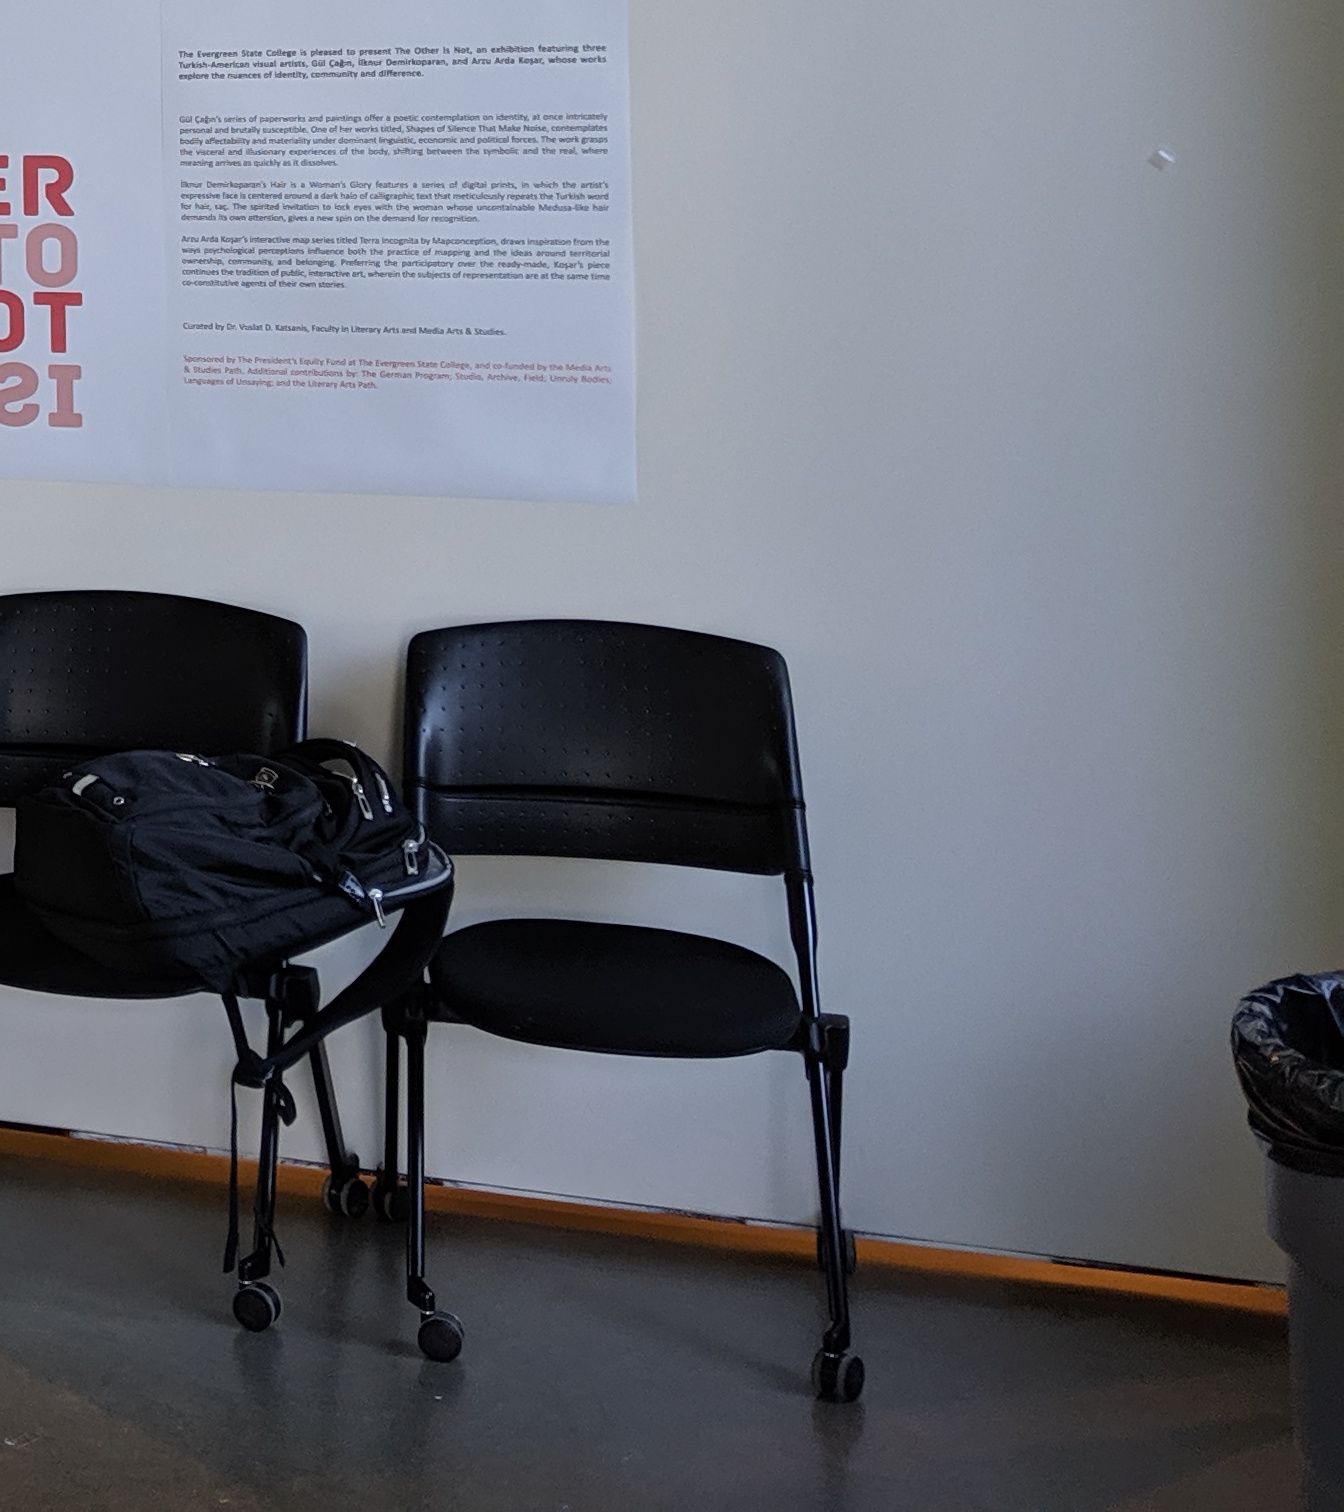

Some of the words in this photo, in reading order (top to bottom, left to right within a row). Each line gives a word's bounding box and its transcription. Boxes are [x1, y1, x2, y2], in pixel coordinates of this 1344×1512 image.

[178, 50, 193, 58] The
[197, 49, 237, 60] Evergreen
[241, 48, 262, 57] State
[266, 48, 296, 58] College
[300, 48, 306, 56] is
[310, 47, 342, 58] pleased
[346, 47, 355, 55] to
[359, 46, 391, 57] present
[395, 46, 410, 54] The
[414, 46, 438, 54] Other
[443, 45, 449, 54] Is
[490, 44, 534, 53] exhibition
[538, 43, 578, 54] featuring
[582, 43, 606, 51] three
[280, 59, 308, 68] artists,
[452, 56, 468, 65] and
[494, 56, 514, 64] Arda
[548, 55, 576, 63] whose
[179, 71, 208, 81] explore
[211, 71, 225, 79] the
[263, 70, 272, 78] of
[360, 69, 375, 77] and
[224, 114, 246, 123] series
[248, 114, 256, 122] of
[260, 114, 305, 124] paperworks
[308, 114, 322, 122] and
[326, 113, 362, 124] paintings
[364, 113, 383, 122] offer
[393, 113, 418, 123] poetic
[180, 125, 212, 136] personal
[214, 125, 228, 134] and
[406, 124, 434, 134] Shapes
[478, 124, 495, 132] That
[498, 123, 520, 132] Make
[313, 136, 335, 144] under
[418, 135, 457, 144] economic
[460, 135, 475, 143] and
[477, 135, 509, 145] political
[541, 135, 556, 143] The
[558, 135, 579, 143] work
[289, 147, 336, 157] experiences
[339, 147, 348, 155] of
[351, 147, 364, 155] the
[368, 147, 389, 157] body,
[426, 146, 462, 155] between
[465, 146, 479, 155] the
[523, 146, 538, 154] and
[581, 146, 608, 154] where
[253, 158, 280, 168] quickly
[300, 158, 338, 166] dissolves.
[375, 180, 408, 188] features
[461, 180, 486, 190] digital
[491, 180, 517, 190] prints,
[562, 180, 576, 188] the
[181, 191, 220, 201] expressive
[222, 191, 238, 199] face
[248, 191, 282, 199] centered
[320, 191, 338, 199] dark
[416, 191, 432, 199] text
[434, 191, 450, 199] that
[507, 191, 537, 202] repeats
[556, 191, 585, 200] Turkish
[232, 202, 247, 210] The
[353, 204, 371, 212] eyes
[375, 202, 392, 210] with
[446, 202, 473, 211] whose
[288, 213, 307, 223] gives
[336, 213, 352, 223] spin
[250, 235, 290, 243] interactive
[312, 235, 334, 243] series
[336, 235, 357, 244] titled
[360, 235, 379, 244] Terra
[421, 236, 430, 246] by
[501, 237, 525, 245] draws
[573, 237, 593, 246] from
[307, 246, 344, 255] influence
[348, 247, 366, 255] both
[370, 247, 383, 255] the
[387, 247, 419, 257] practice
[182, 267, 219, 275] continues
[588, 260, 609, 271] piece
[241, 278, 266, 289] agents
[279, 279, 297, 287] their
[183, 321, 213, 330] Curated
[215, 322, 224, 332] by
[311, 324, 339, 334] Faculty
[383, 325, 399, 333] Arts
[401, 325, 416, 334] and
[418, 326, 444, 334] Media
[446, 326, 462, 335] Arts
[465, 326, 471, 335] &
[238, 355, 252, 363] The
[417, 359, 437, 368] State
[475, 360, 490, 369] and
[340, 379, 355, 388] Arts
